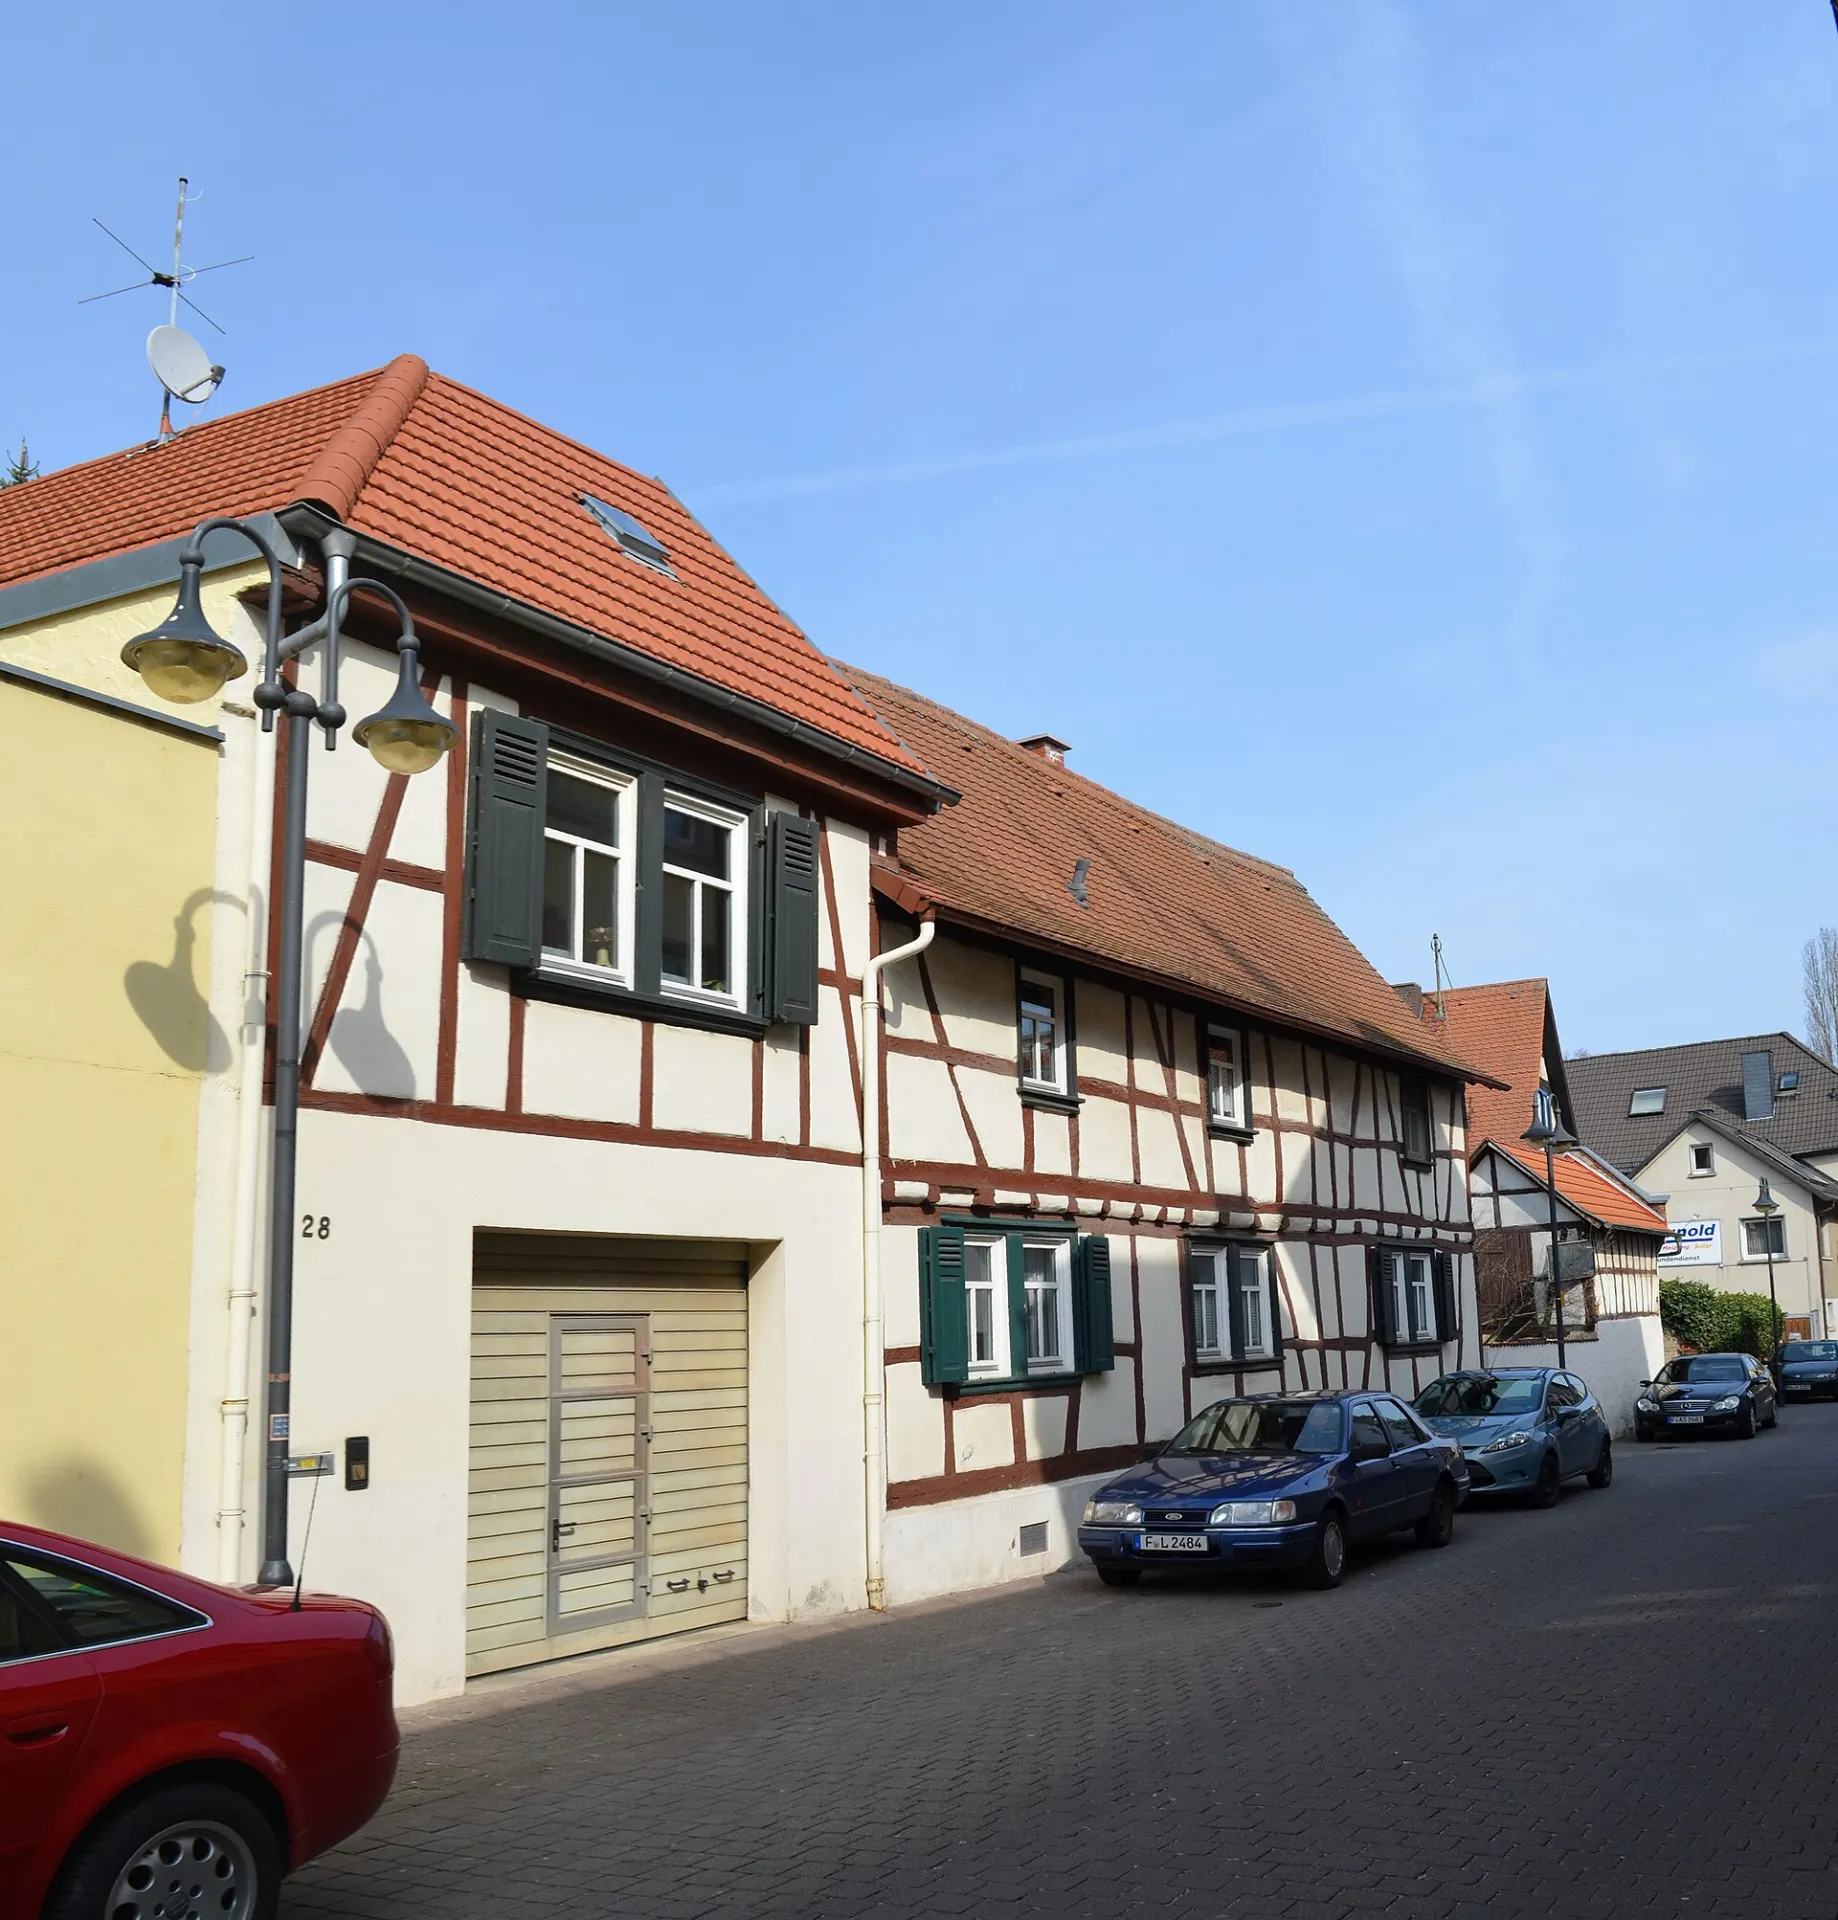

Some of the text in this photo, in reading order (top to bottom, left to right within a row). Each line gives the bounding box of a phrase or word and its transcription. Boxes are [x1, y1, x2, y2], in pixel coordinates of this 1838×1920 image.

[302, 1214, 331, 1240] 28
[1672, 1223, 1716, 1237] nold
[1145, 1536, 1153, 1548] F
[1171, 1537, 1202, 1549] 2484
